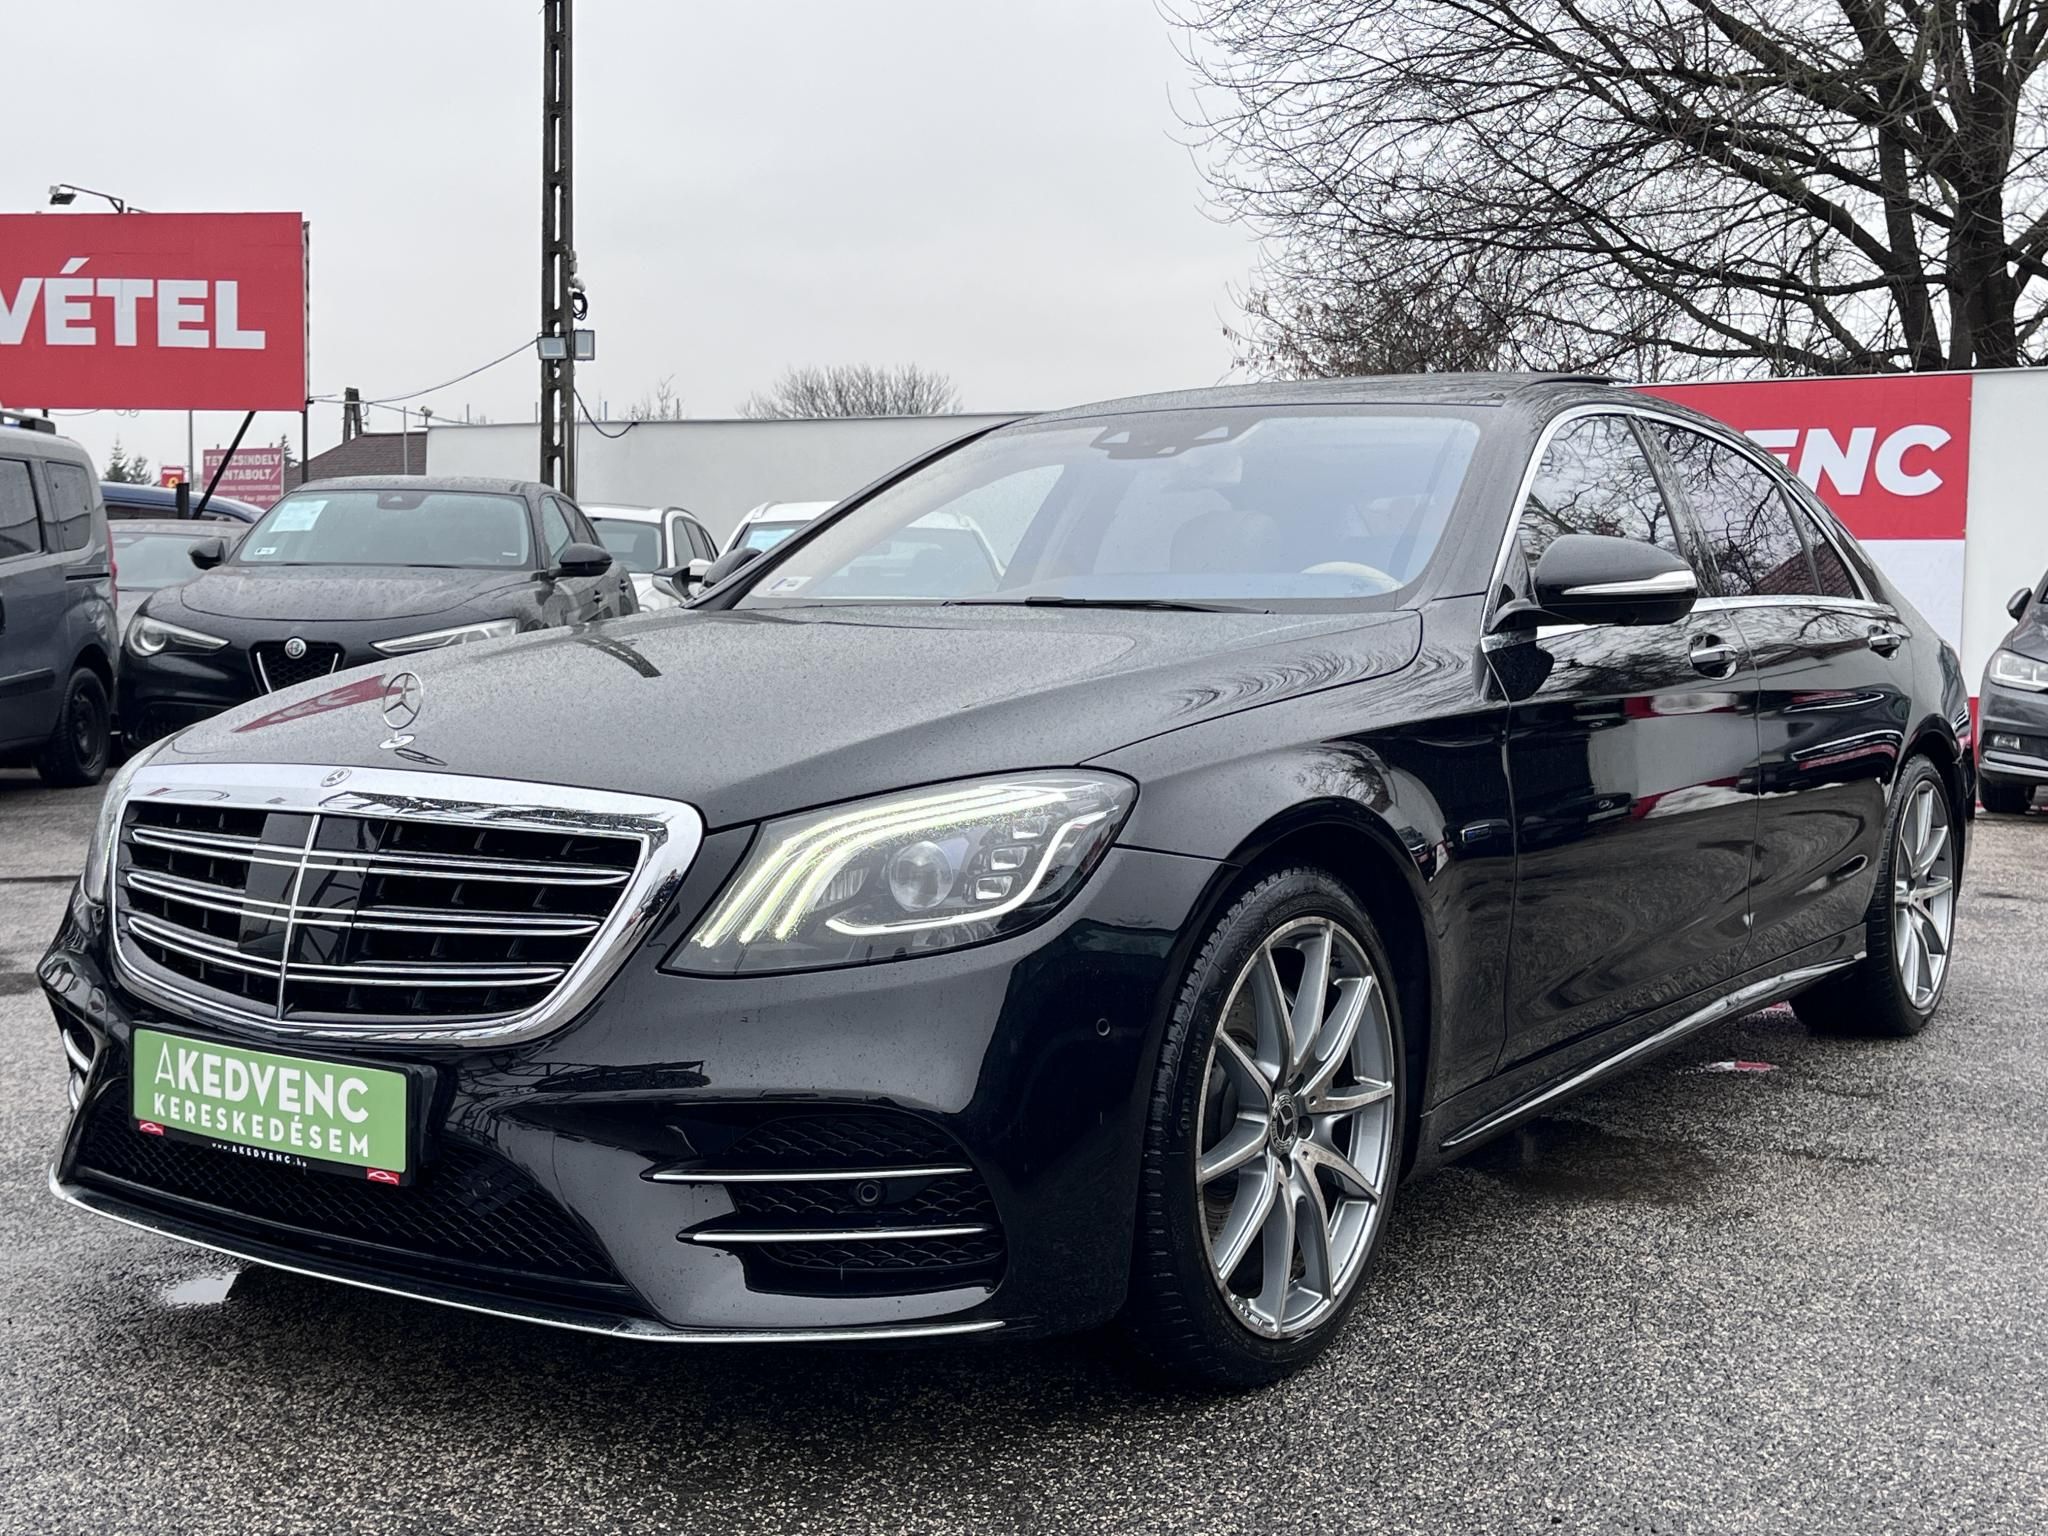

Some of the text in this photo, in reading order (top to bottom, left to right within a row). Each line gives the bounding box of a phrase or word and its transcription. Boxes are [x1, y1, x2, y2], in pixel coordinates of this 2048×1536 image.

[0, 257, 266, 350] VÉTEL
[154, 1041, 369, 1123] AKEDVENC
[154, 1093, 369, 1158] KERESKEDÉSEM
